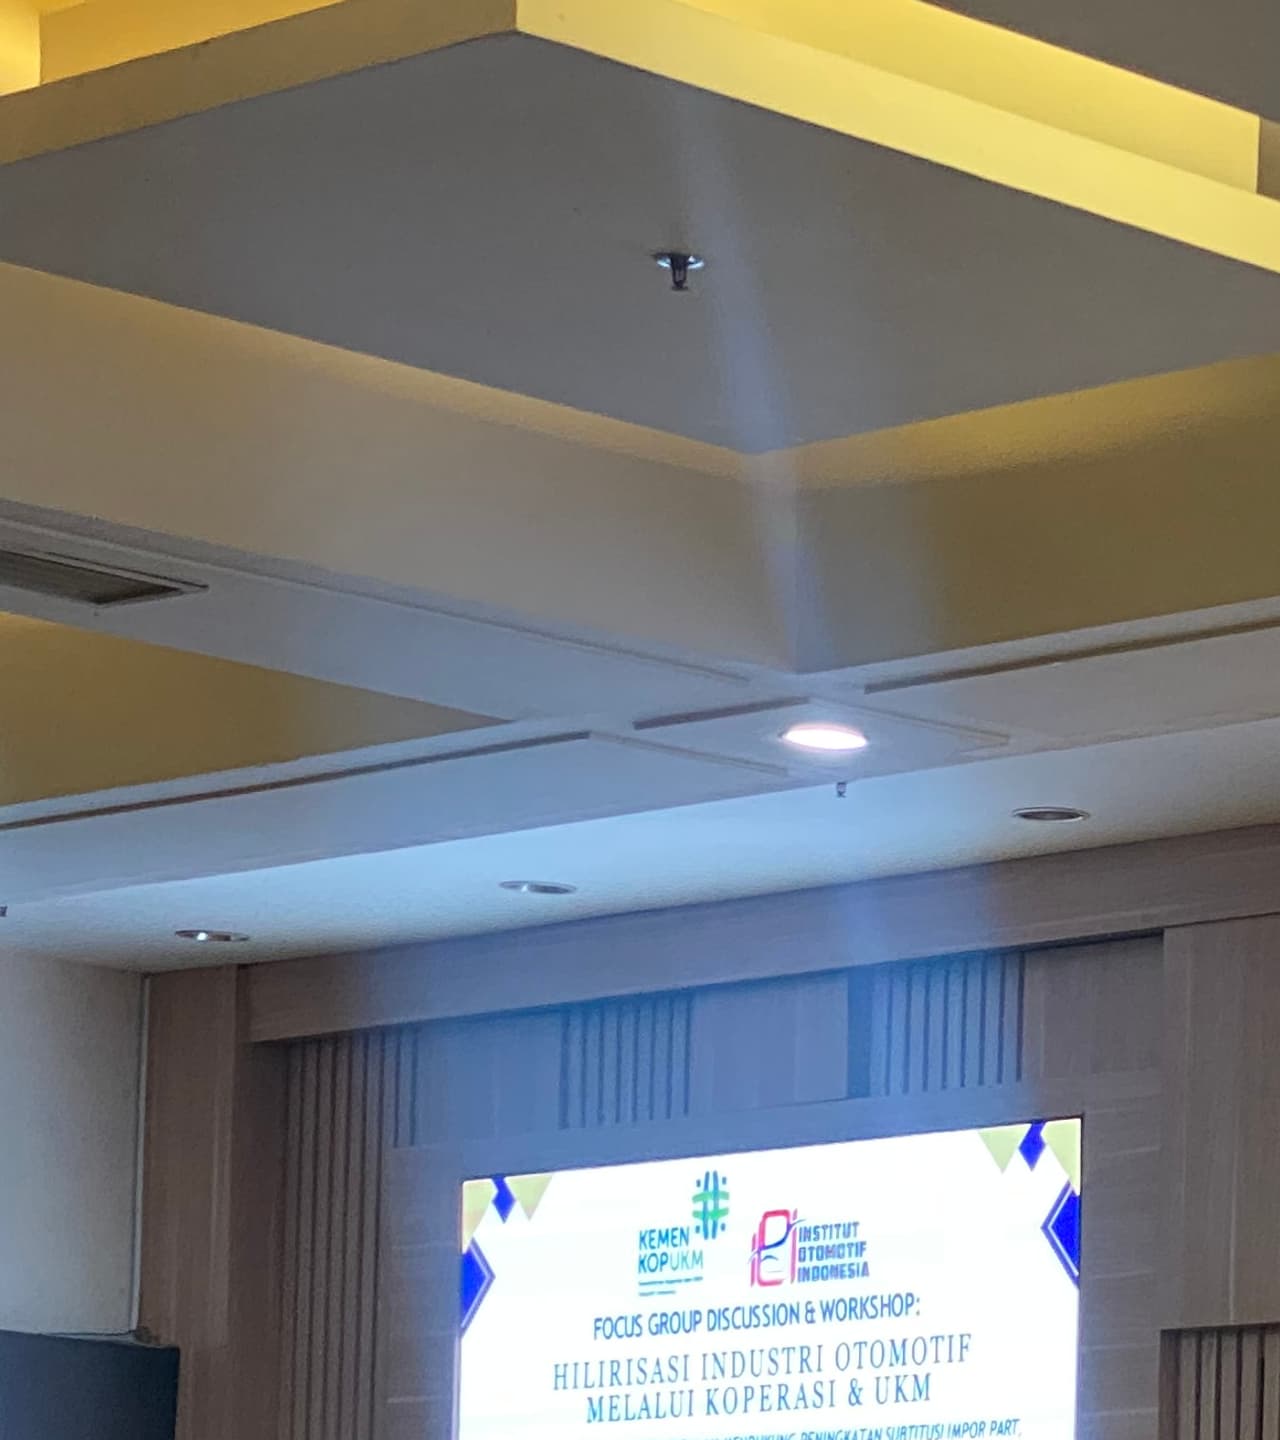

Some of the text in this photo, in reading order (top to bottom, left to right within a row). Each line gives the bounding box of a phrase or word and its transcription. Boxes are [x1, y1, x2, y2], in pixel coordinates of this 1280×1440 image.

[639, 1227, 690, 1250] KEMEN
[799, 1222, 860, 1242] INSTITUT
[638, 1250, 703, 1274] KOPUKM
[798, 1241, 867, 1262] OTOMOTIF
[798, 1261, 870, 1283] INDONESIA
[594, 1292, 920, 1340] FOCUS GROUP DISCUSSION & WORKSHOP:
[553, 1333, 971, 1390] HILIRISASI INDUSTRI OTOMOTIF
[587, 1373, 932, 1423] MELALUI KOPERASI & UKM
[948, 1421, 986, 1439] IMPOR
